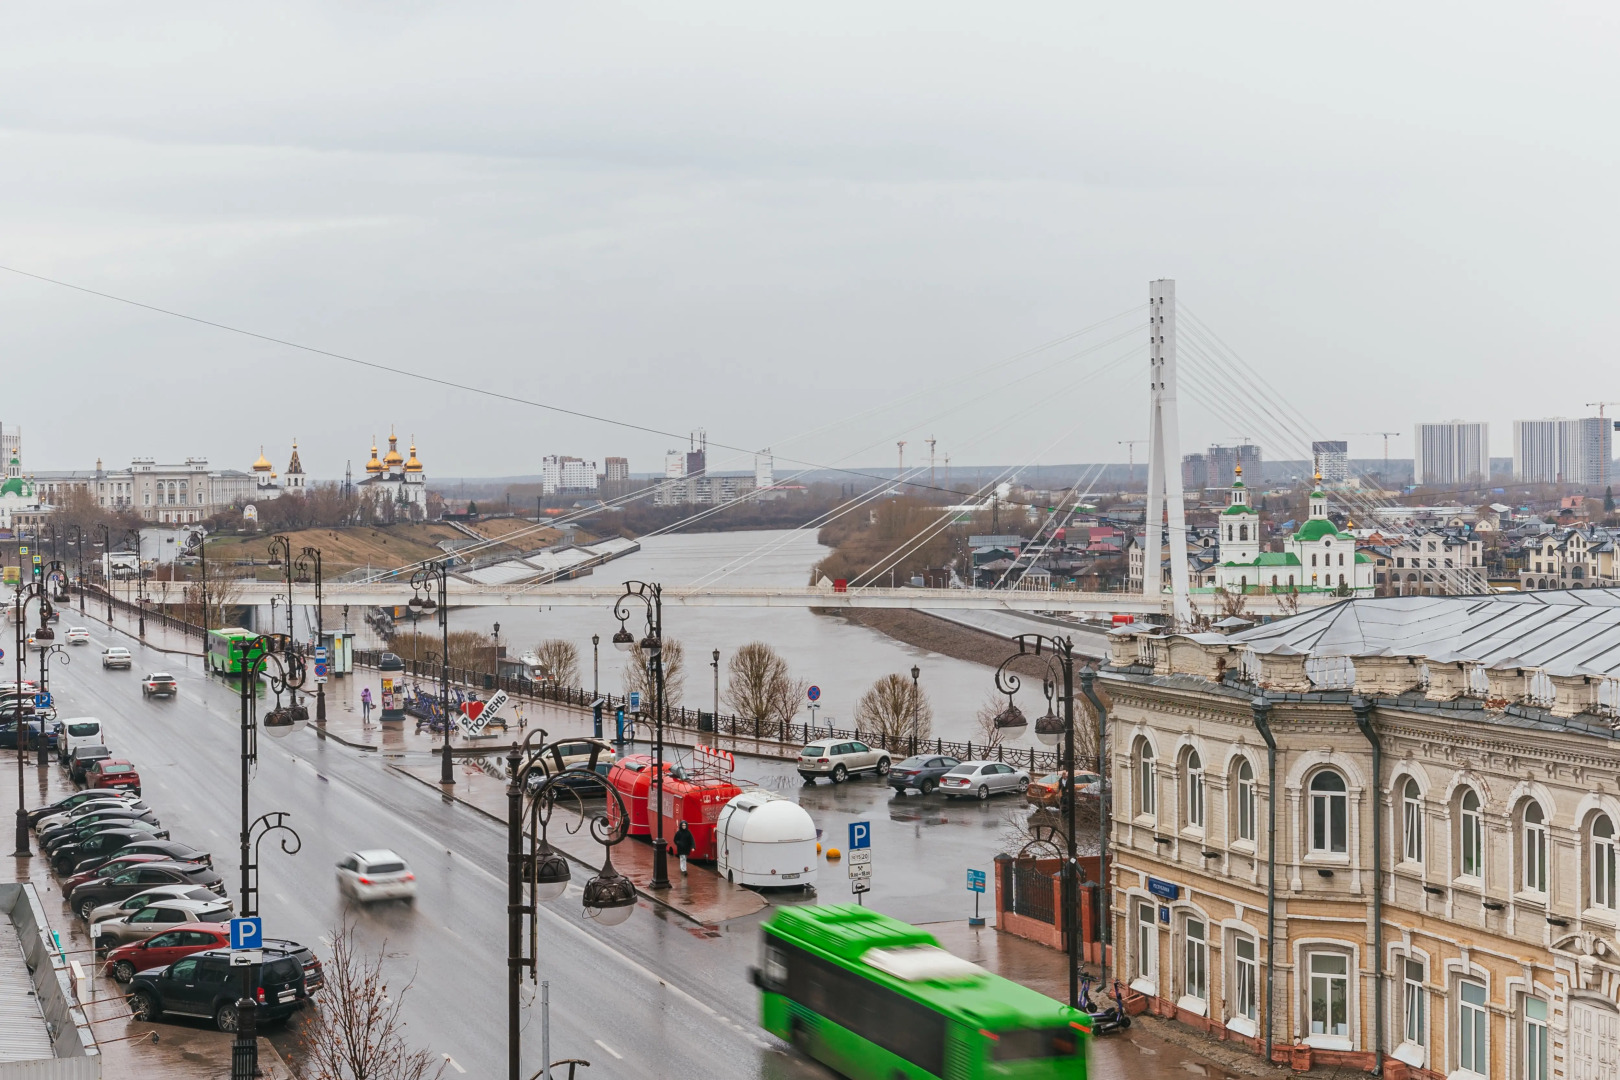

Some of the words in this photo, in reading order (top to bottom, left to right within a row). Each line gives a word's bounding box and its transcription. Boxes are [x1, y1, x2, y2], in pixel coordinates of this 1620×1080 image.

[469, 695, 506, 734] ТЮМЕНЬ
[854, 824, 866, 846] P
[239, 921, 257, 946] P
